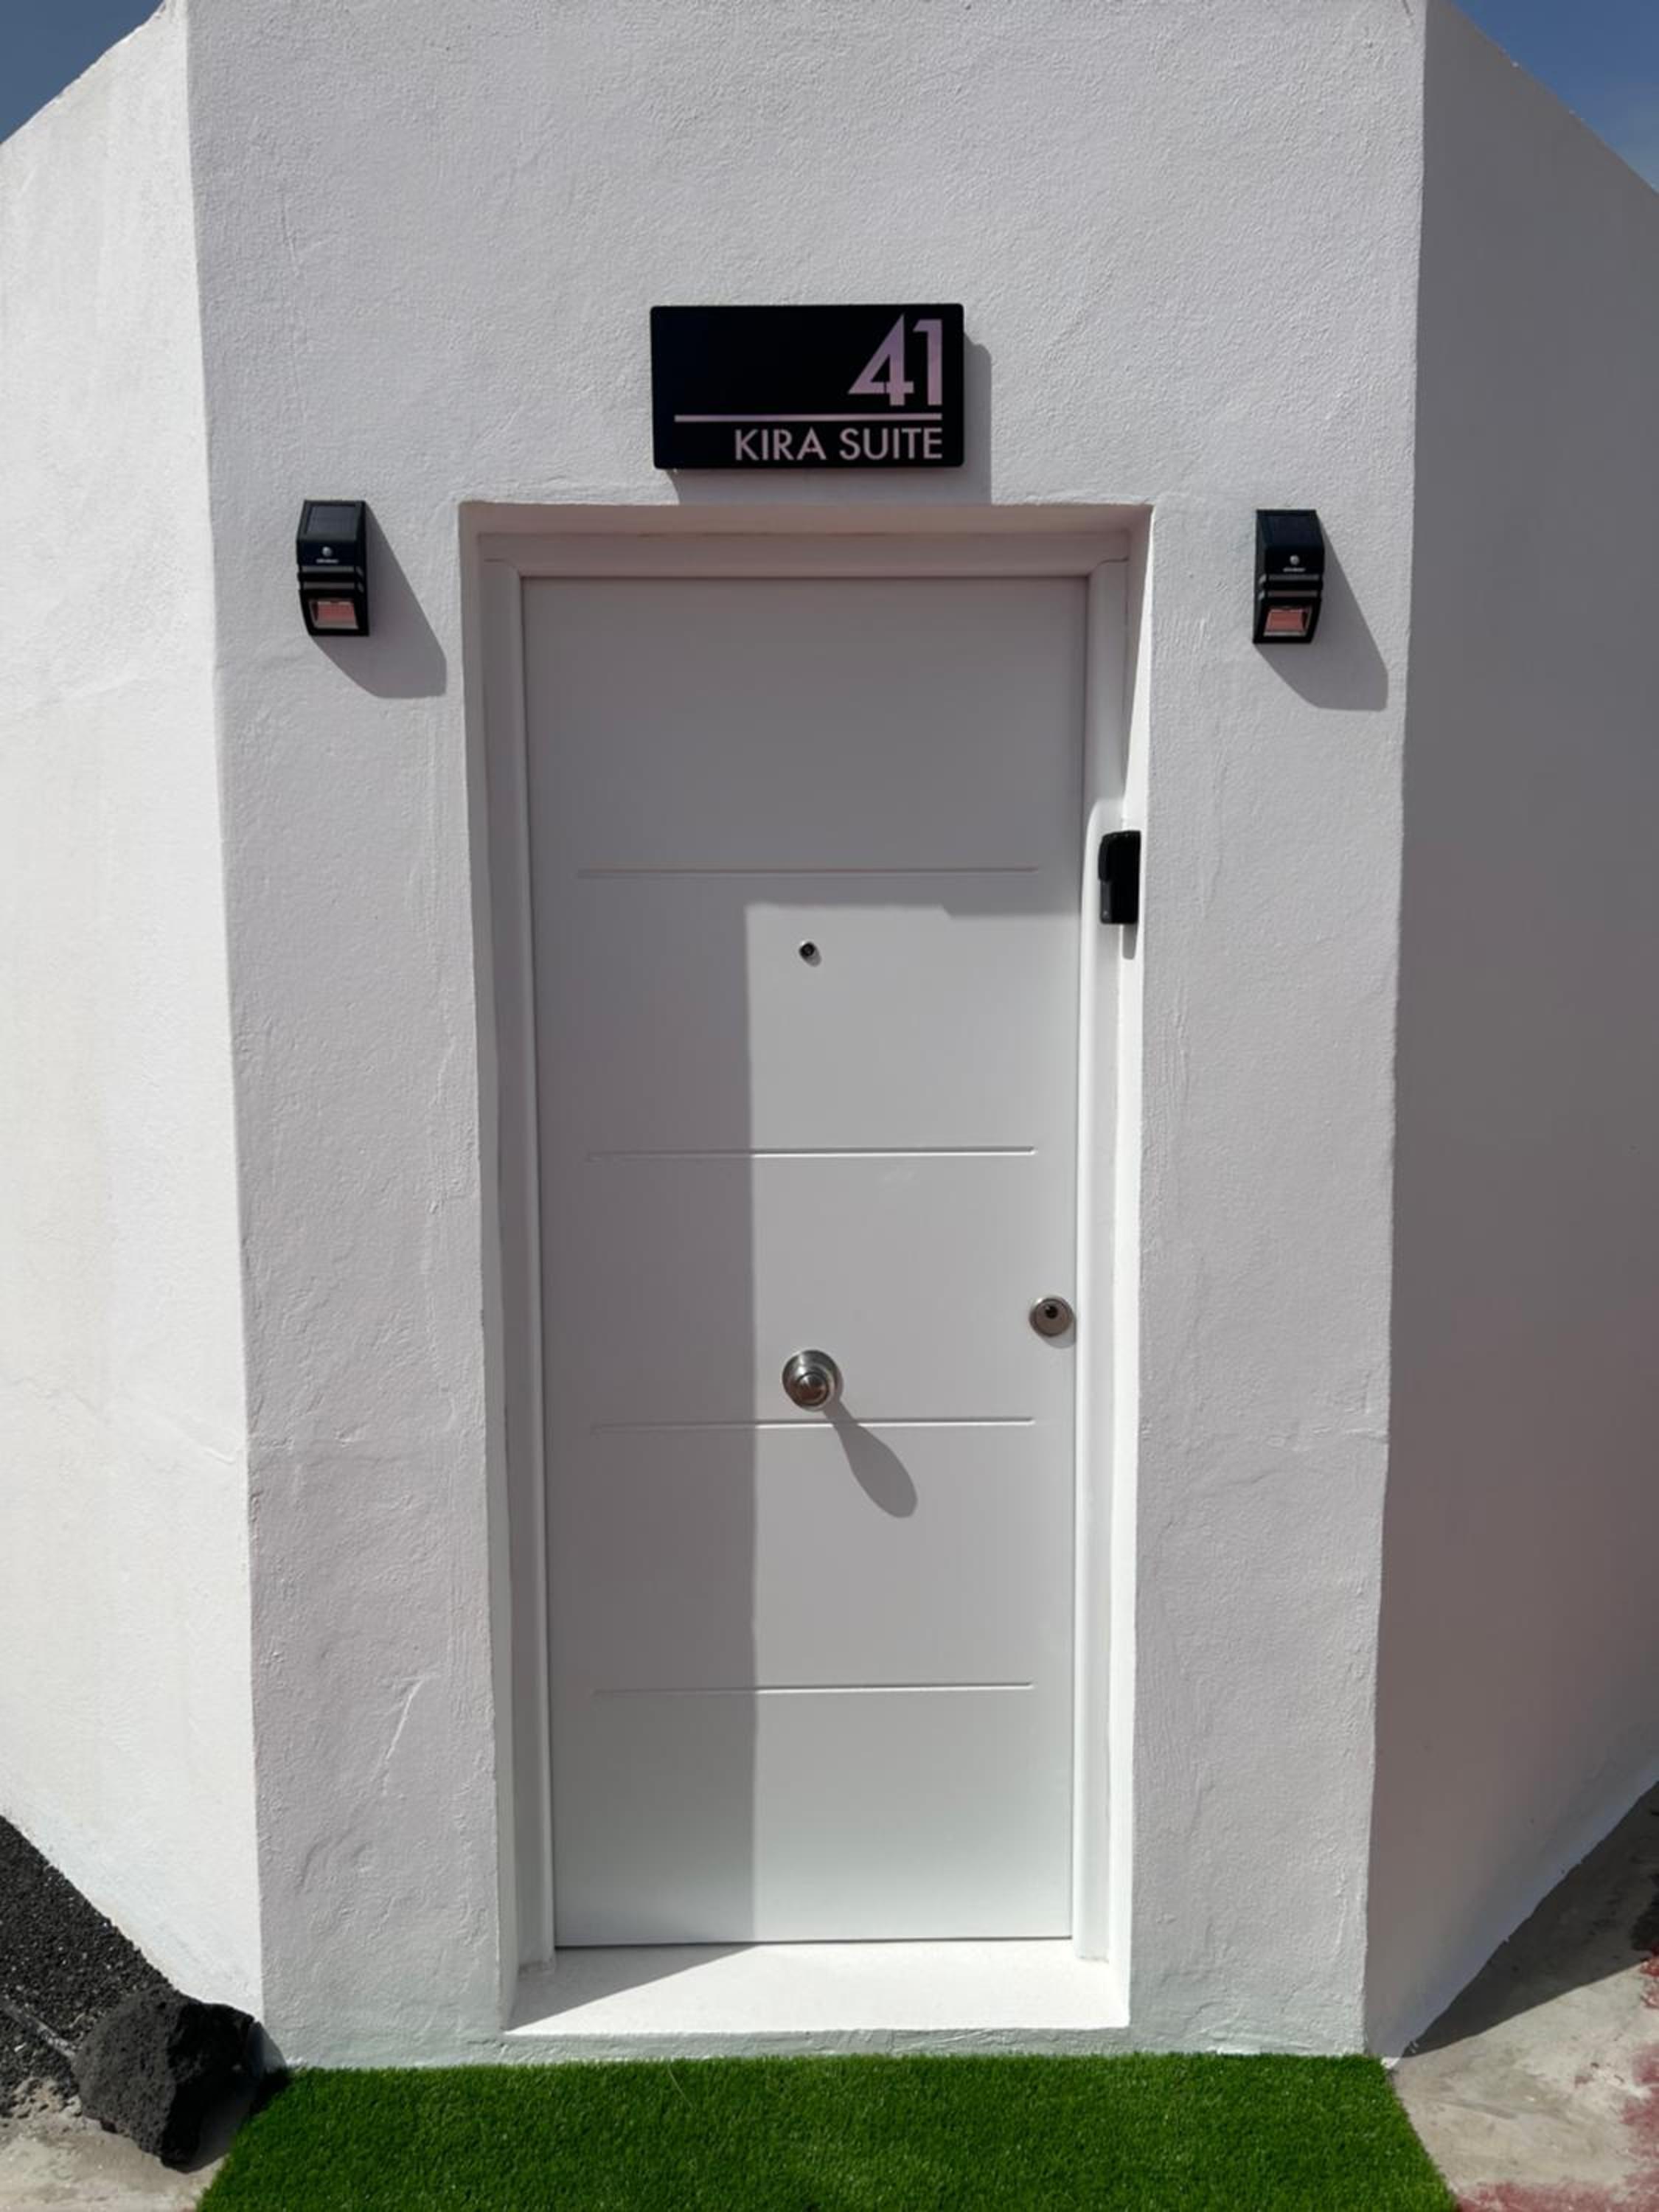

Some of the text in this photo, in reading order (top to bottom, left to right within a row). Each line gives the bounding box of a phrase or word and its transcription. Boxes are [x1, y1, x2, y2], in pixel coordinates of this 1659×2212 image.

[848, 313, 942, 406] 41
[735, 427, 942, 461] KIRA SUITE
